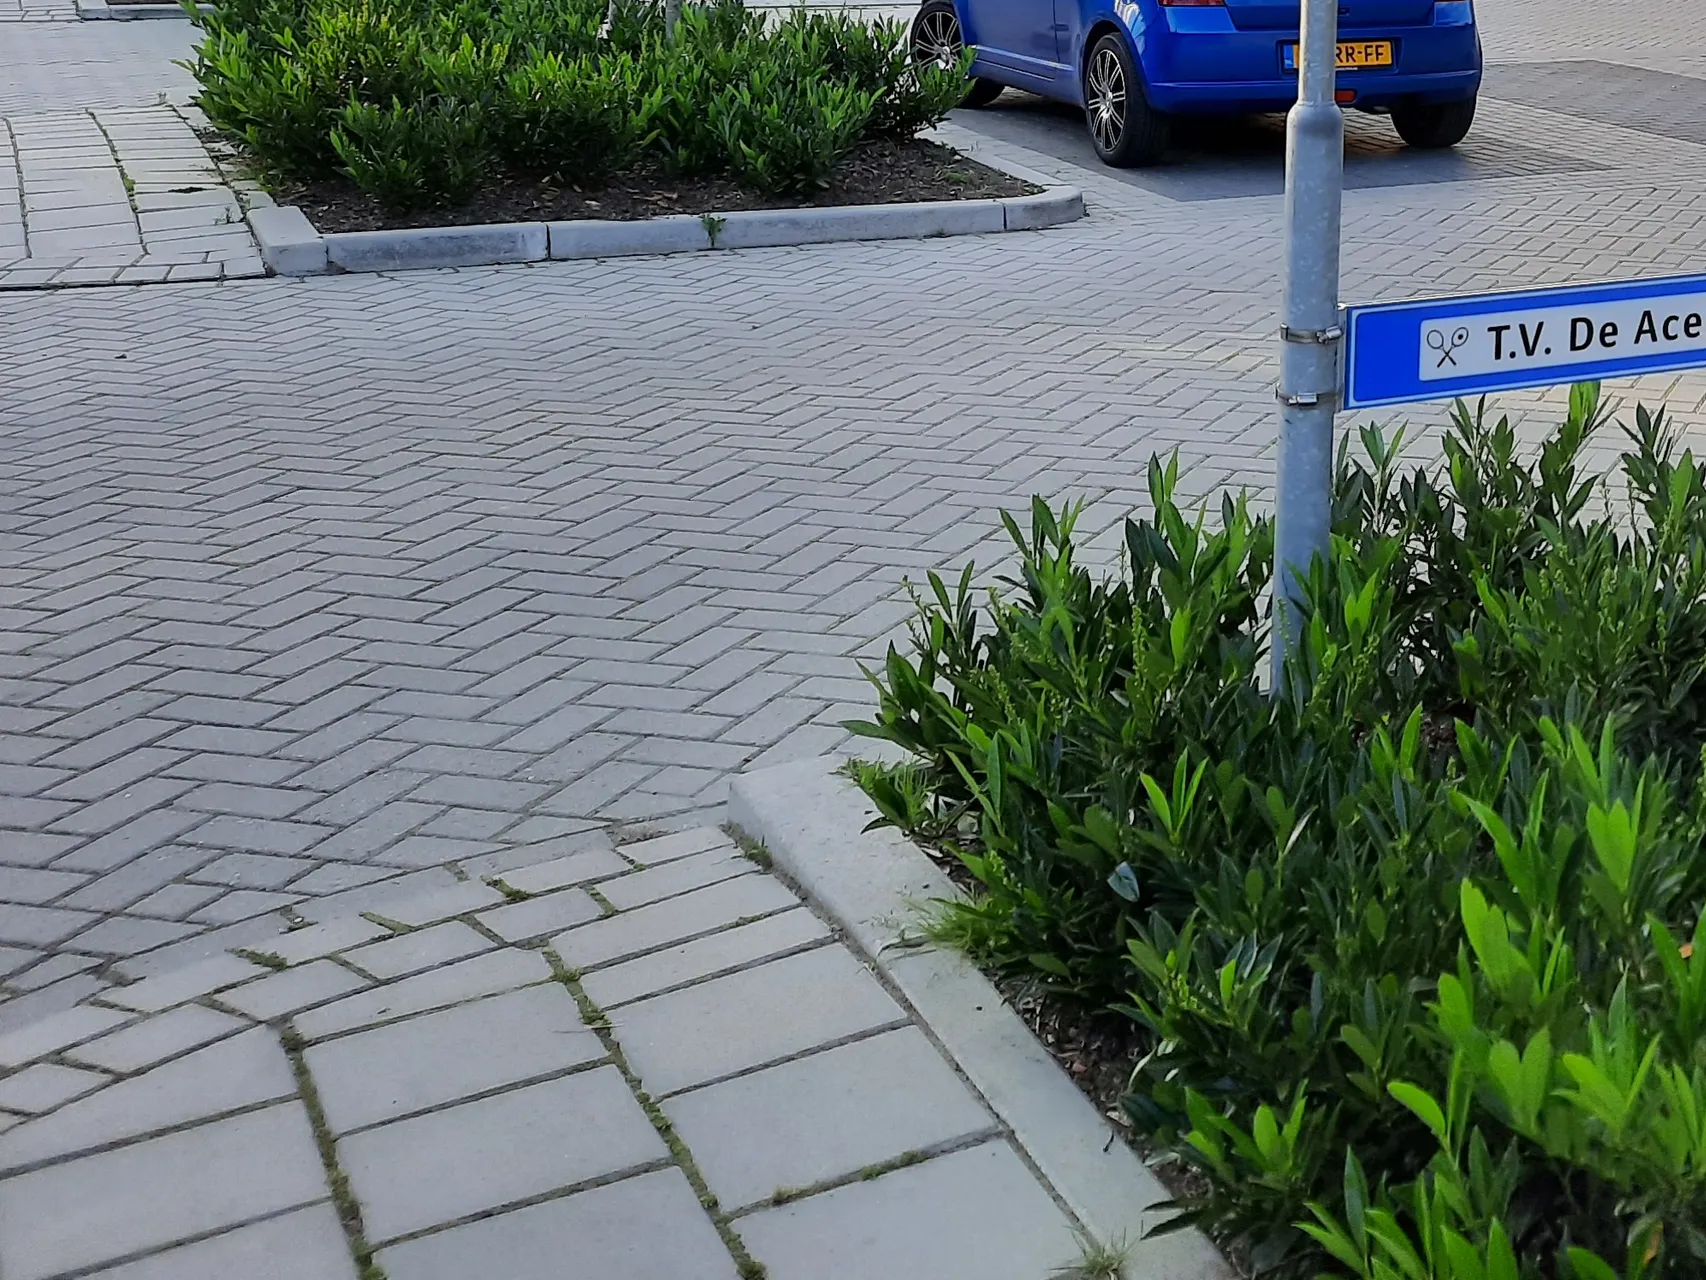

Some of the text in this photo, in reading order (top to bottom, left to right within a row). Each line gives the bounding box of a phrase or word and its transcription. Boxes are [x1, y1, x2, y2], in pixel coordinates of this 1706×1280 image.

[1335, 44, 1385, 64] RR-FF
[1487, 321, 1552, 361] T.V.
[1569, 317, 1619, 352] De
